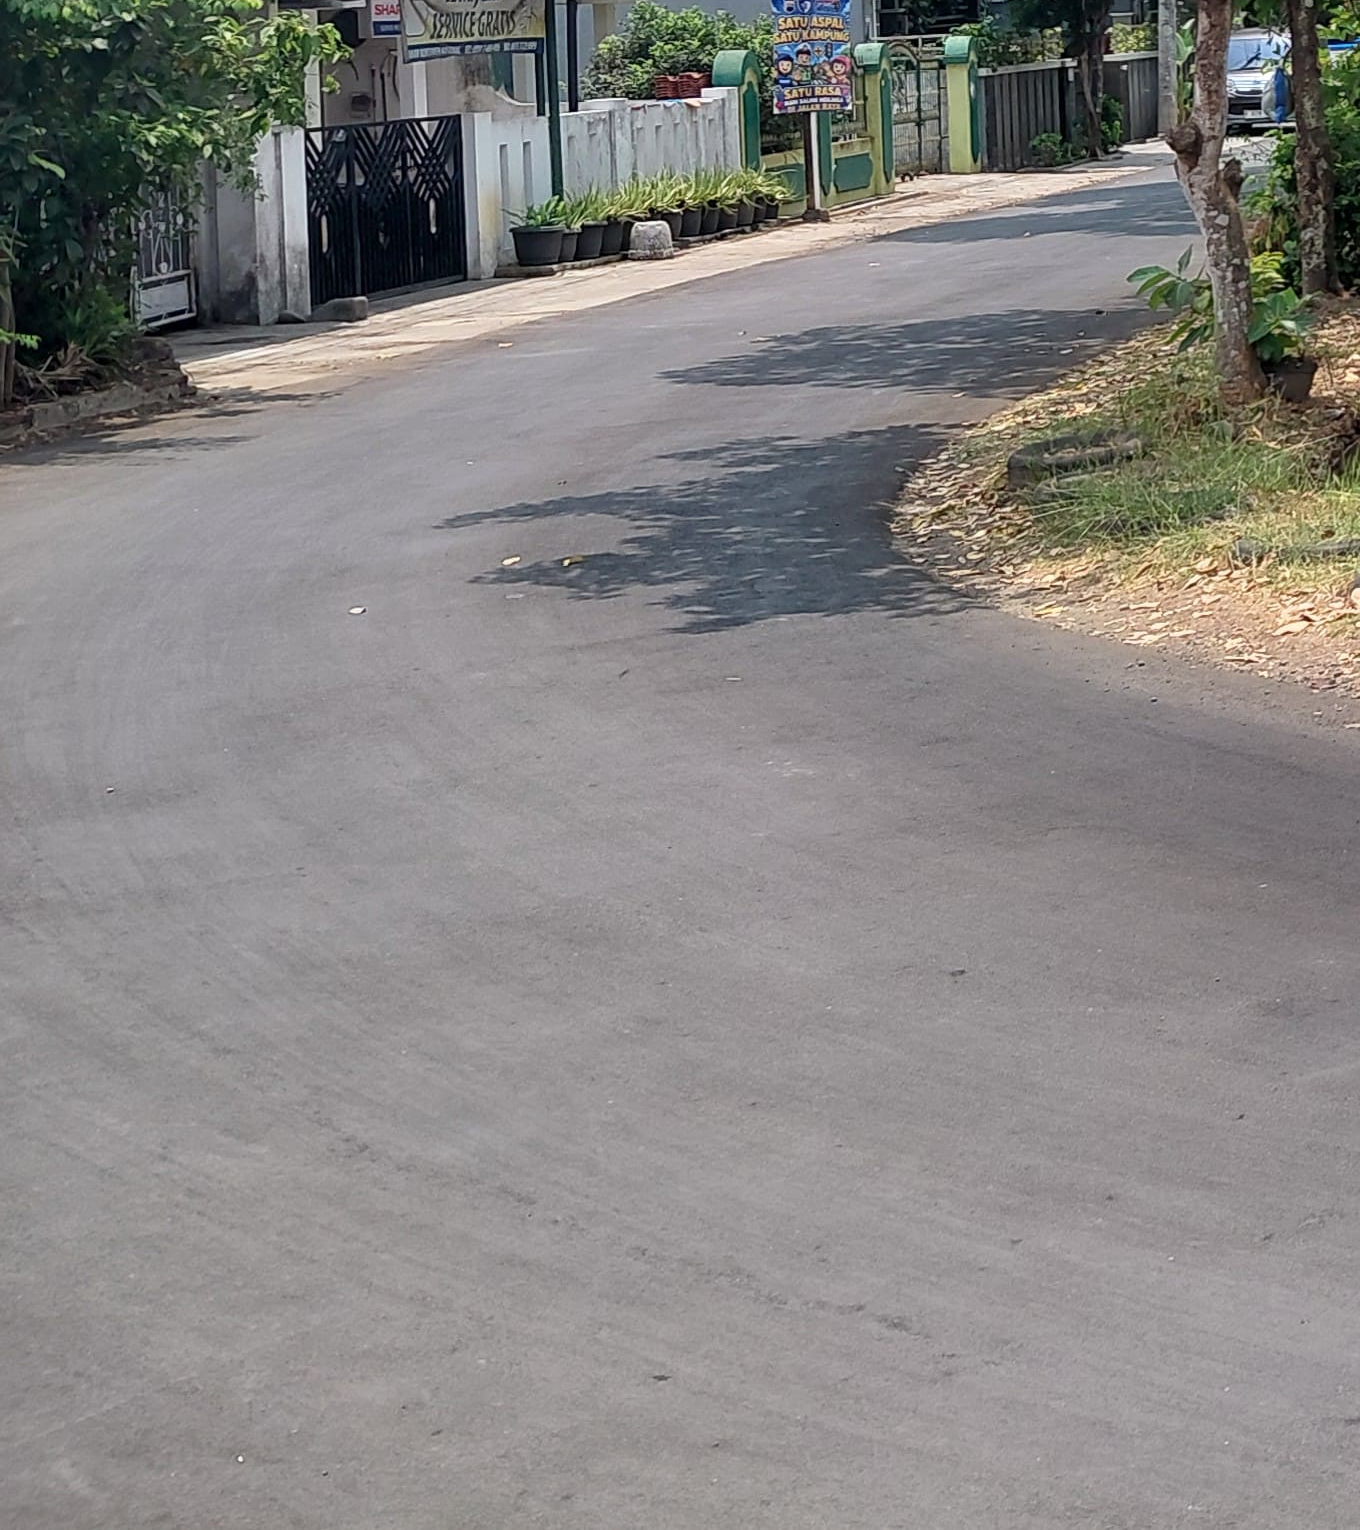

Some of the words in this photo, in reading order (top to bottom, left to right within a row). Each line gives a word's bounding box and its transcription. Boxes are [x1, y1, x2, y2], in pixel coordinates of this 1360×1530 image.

[430, 11, 477, 39] SERVICE
[477, 10, 516, 37] GRATIS
[778, 16, 808, 30] SATU
[810, 16, 844, 29] ASPAL
[773, 30, 800, 44] SATU
[802, 30, 849, 42] KAMPUNG
[783, 87, 812, 100] SATU
[814, 86, 842, 96] RASA
